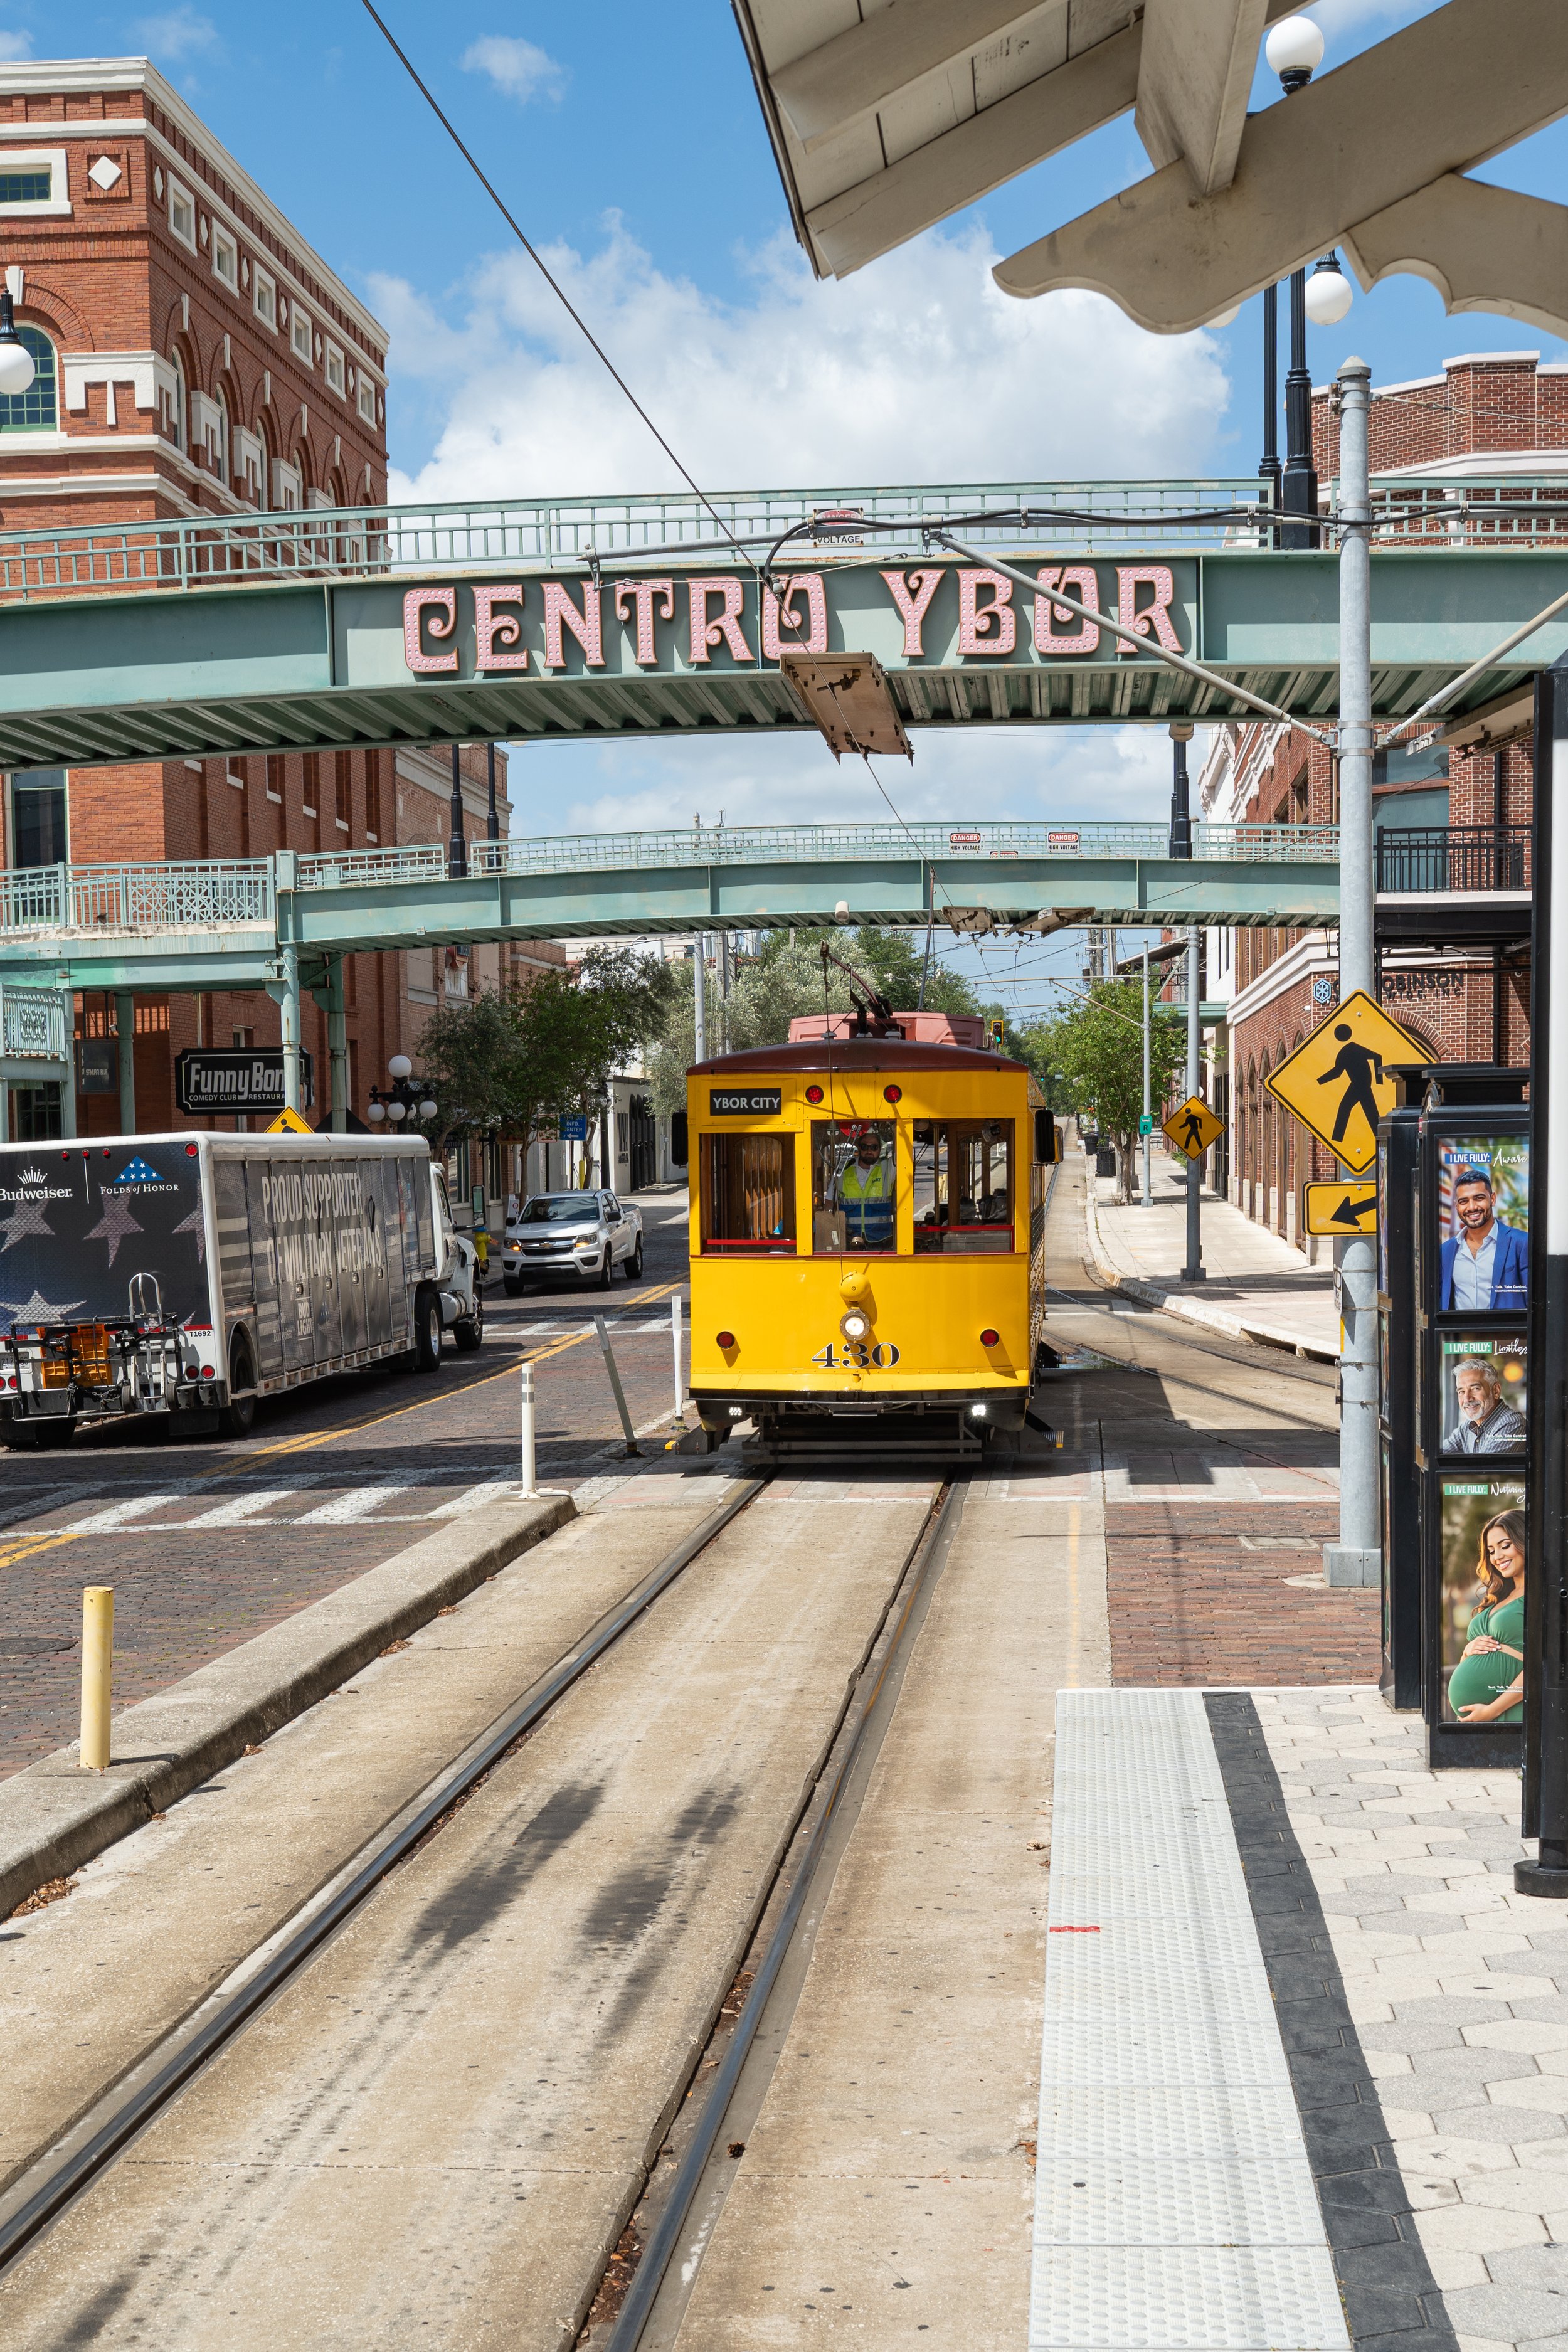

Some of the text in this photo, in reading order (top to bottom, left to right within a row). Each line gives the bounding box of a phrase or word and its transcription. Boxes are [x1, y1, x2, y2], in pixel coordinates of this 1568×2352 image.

[402, 566, 1185, 673] CENTRO YBOR
[1382, 973, 1464, 991] OBINSON
[252, 1062, 285, 1092] Bon
[713, 1097, 780, 1109] YBOR CITY
[1449, 1148, 1527, 1167] I LIVE FULLY: Aware
[100, 1184, 179, 1195] FOLDS of HONOR
[261, 1173, 363, 1223] PROUD SUPPORTER
[267, 1224, 382, 1285] OF MILITARY VETERANS
[298, 1301, 310, 1319] BUD
[297, 1318, 313, 1336] LIGHT
[812, 1342, 901, 1369] 430
[1449, 1343, 1452, 1352] I
[1453, 1343, 1468, 1352] LIVE
[1469, 1343, 1490, 1352] FULLY:
[1449, 1486, 1452, 1494] I
[1468, 1485, 1486, 1493] FULLY:
[1491, 1482, 1525, 1503] Nurturing
